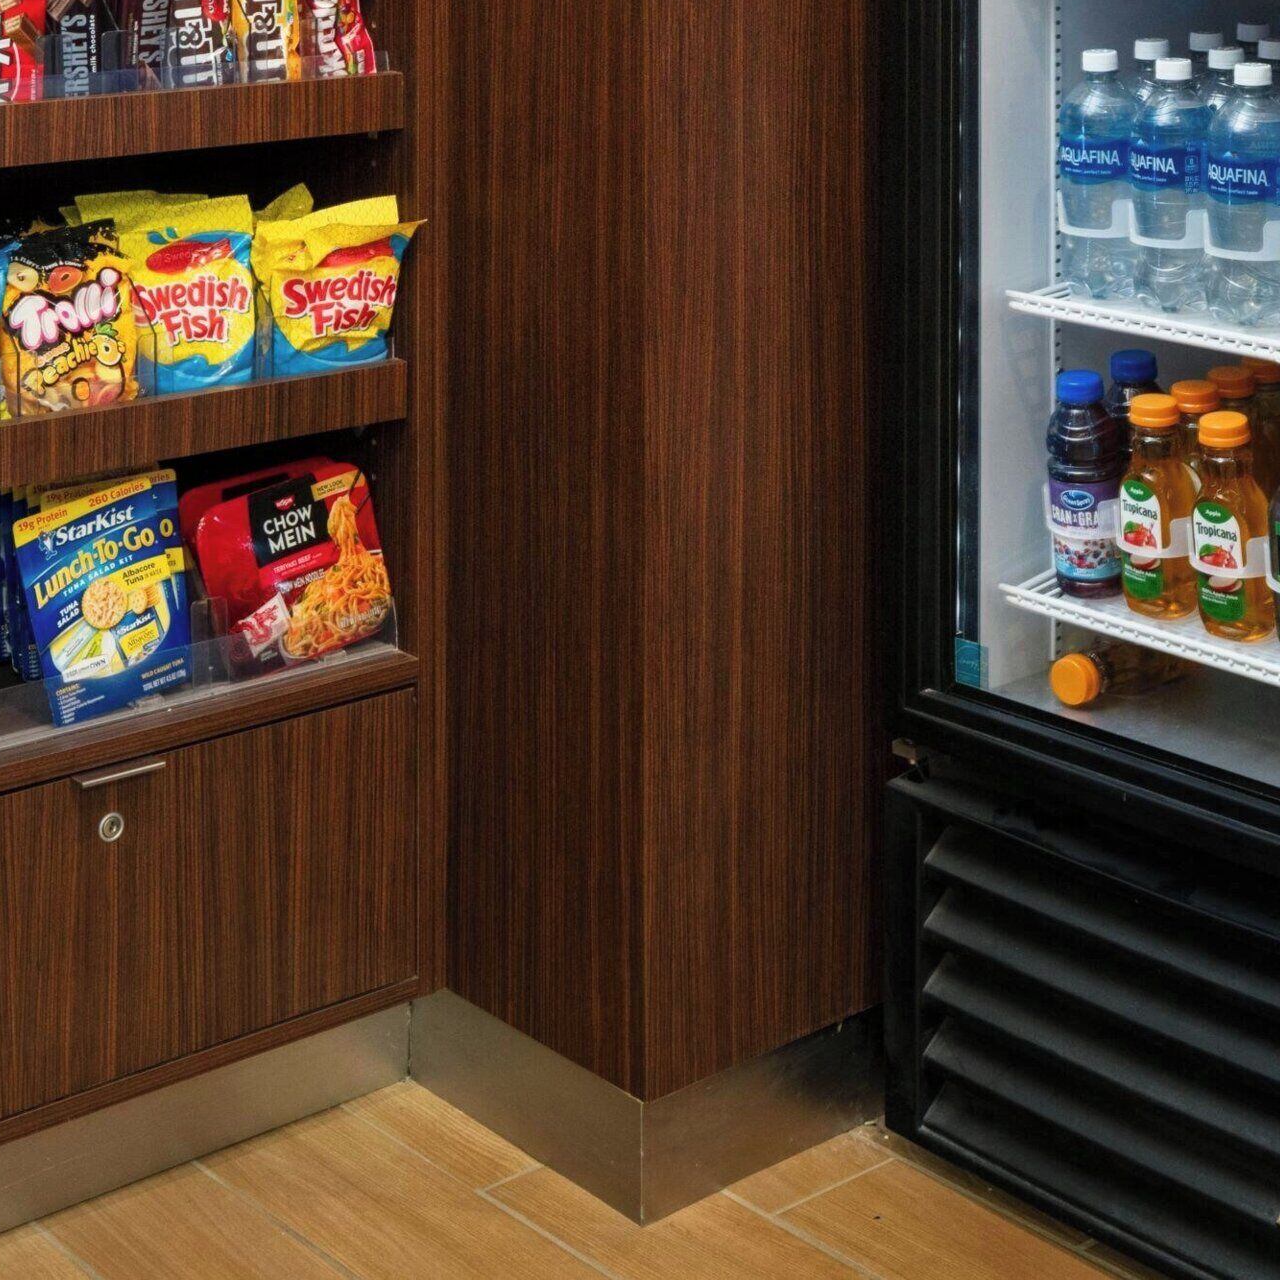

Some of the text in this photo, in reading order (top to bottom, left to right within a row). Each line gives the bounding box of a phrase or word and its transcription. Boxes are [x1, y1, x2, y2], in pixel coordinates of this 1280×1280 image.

[1208, 162, 1268, 186] AQUAFINA
[131, 276, 251, 327] Swedish
[283, 270, 397, 317] Swedish
[10, 283, 122, 350] Trolli
[165, 311, 227, 345] Fish
[310, 303, 379, 337] Fish
[89, 482, 145, 507] 260 Calories
[18, 509, 68, 531] 19g Protein
[263, 504, 312, 535] CHOW
[1122, 499, 1158, 521] Tropicana
[56, 505, 134, 546] StarKist
[268, 522, 315, 554] MEIN
[1196, 522, 1237, 542] Tropicana
[63, 555, 133, 596] TUNA SALAD KIT
[122, 562, 156, 579] Albacore
[125, 576, 144, 586] Tuna
[57, 608, 80, 628] SALAD
[60, 600, 78, 616] TUNA
